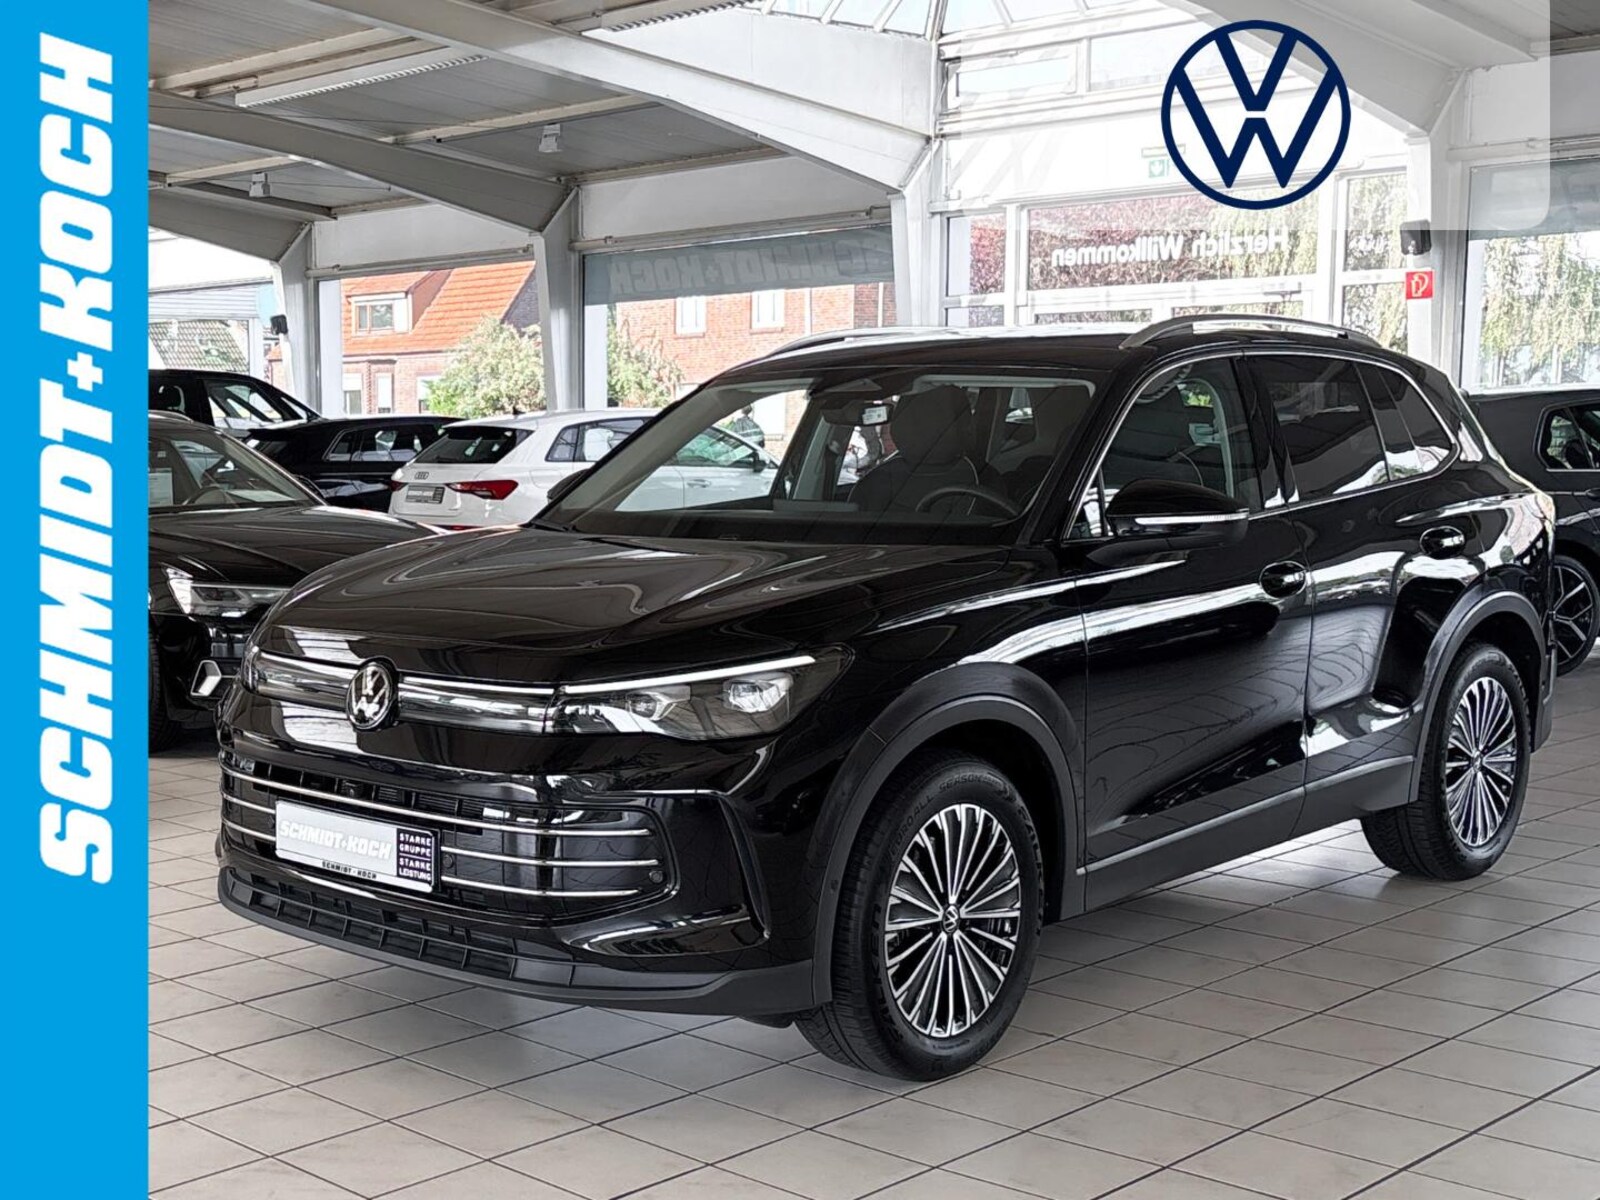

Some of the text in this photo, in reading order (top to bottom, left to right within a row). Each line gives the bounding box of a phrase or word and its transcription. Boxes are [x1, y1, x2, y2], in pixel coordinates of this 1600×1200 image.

[279, 820, 393, 860] SCHMIDT+KOCH
[399, 833, 432, 847] STARKE
[399, 844, 432, 857] GRUPPE
[399, 857, 432, 871] STARKE
